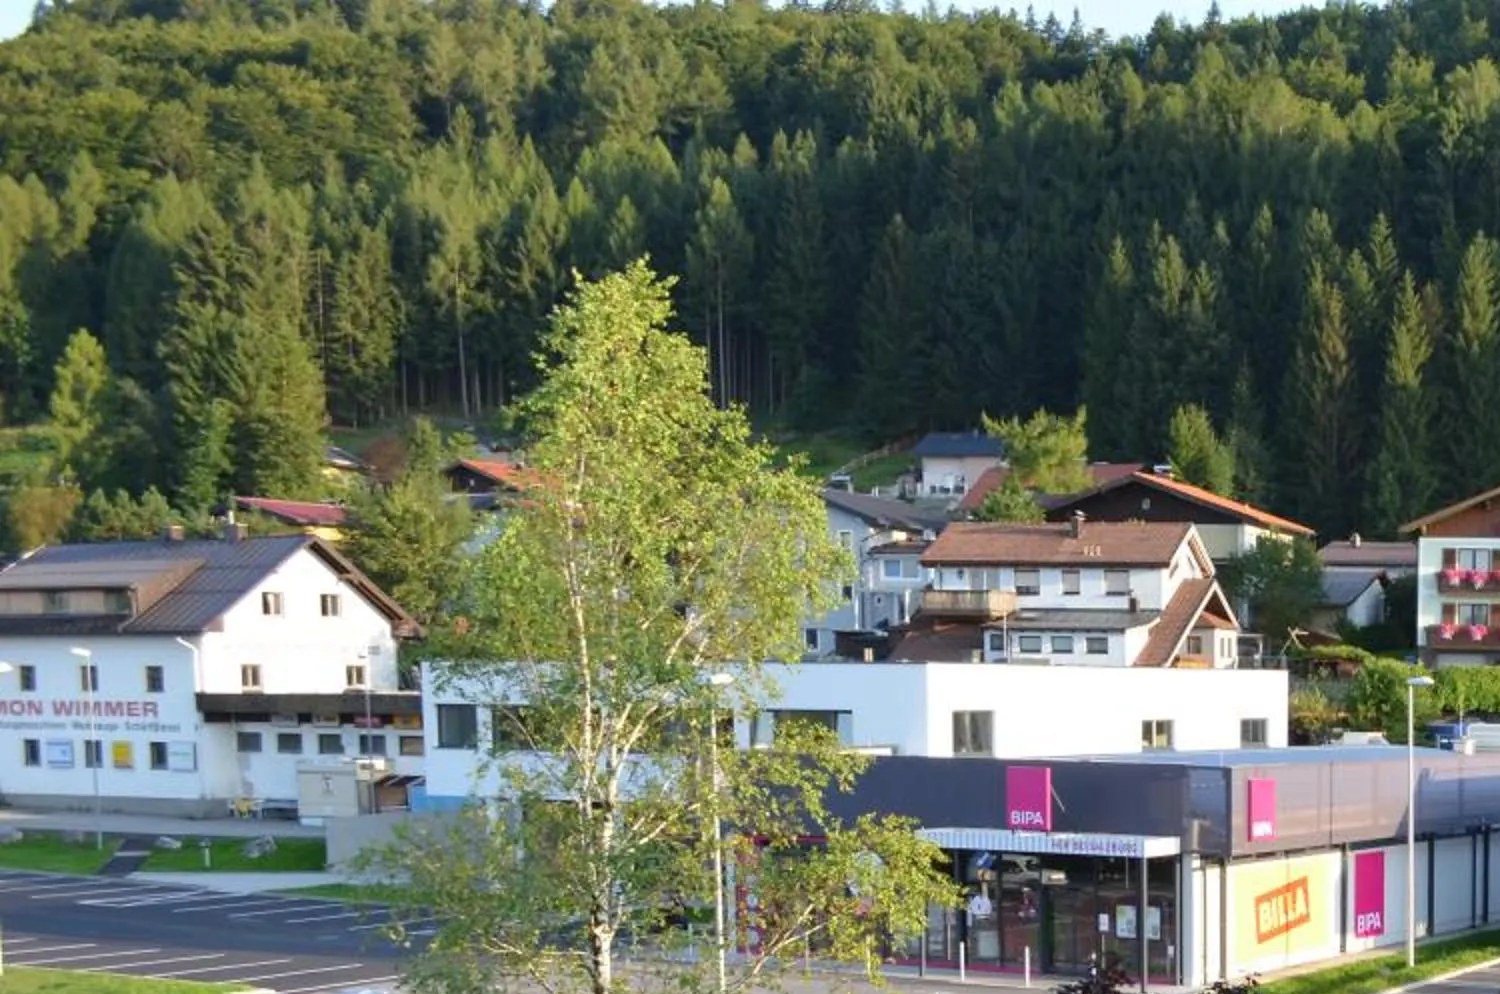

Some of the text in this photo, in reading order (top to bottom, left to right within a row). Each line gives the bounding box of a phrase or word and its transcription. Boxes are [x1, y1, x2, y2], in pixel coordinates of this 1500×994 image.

[51, 700, 159, 717] WIMMER
[1011, 810, 1044, 825] BIPA
[1258, 886, 1308, 935] BILLA
[1357, 911, 1382, 932] BIPA
